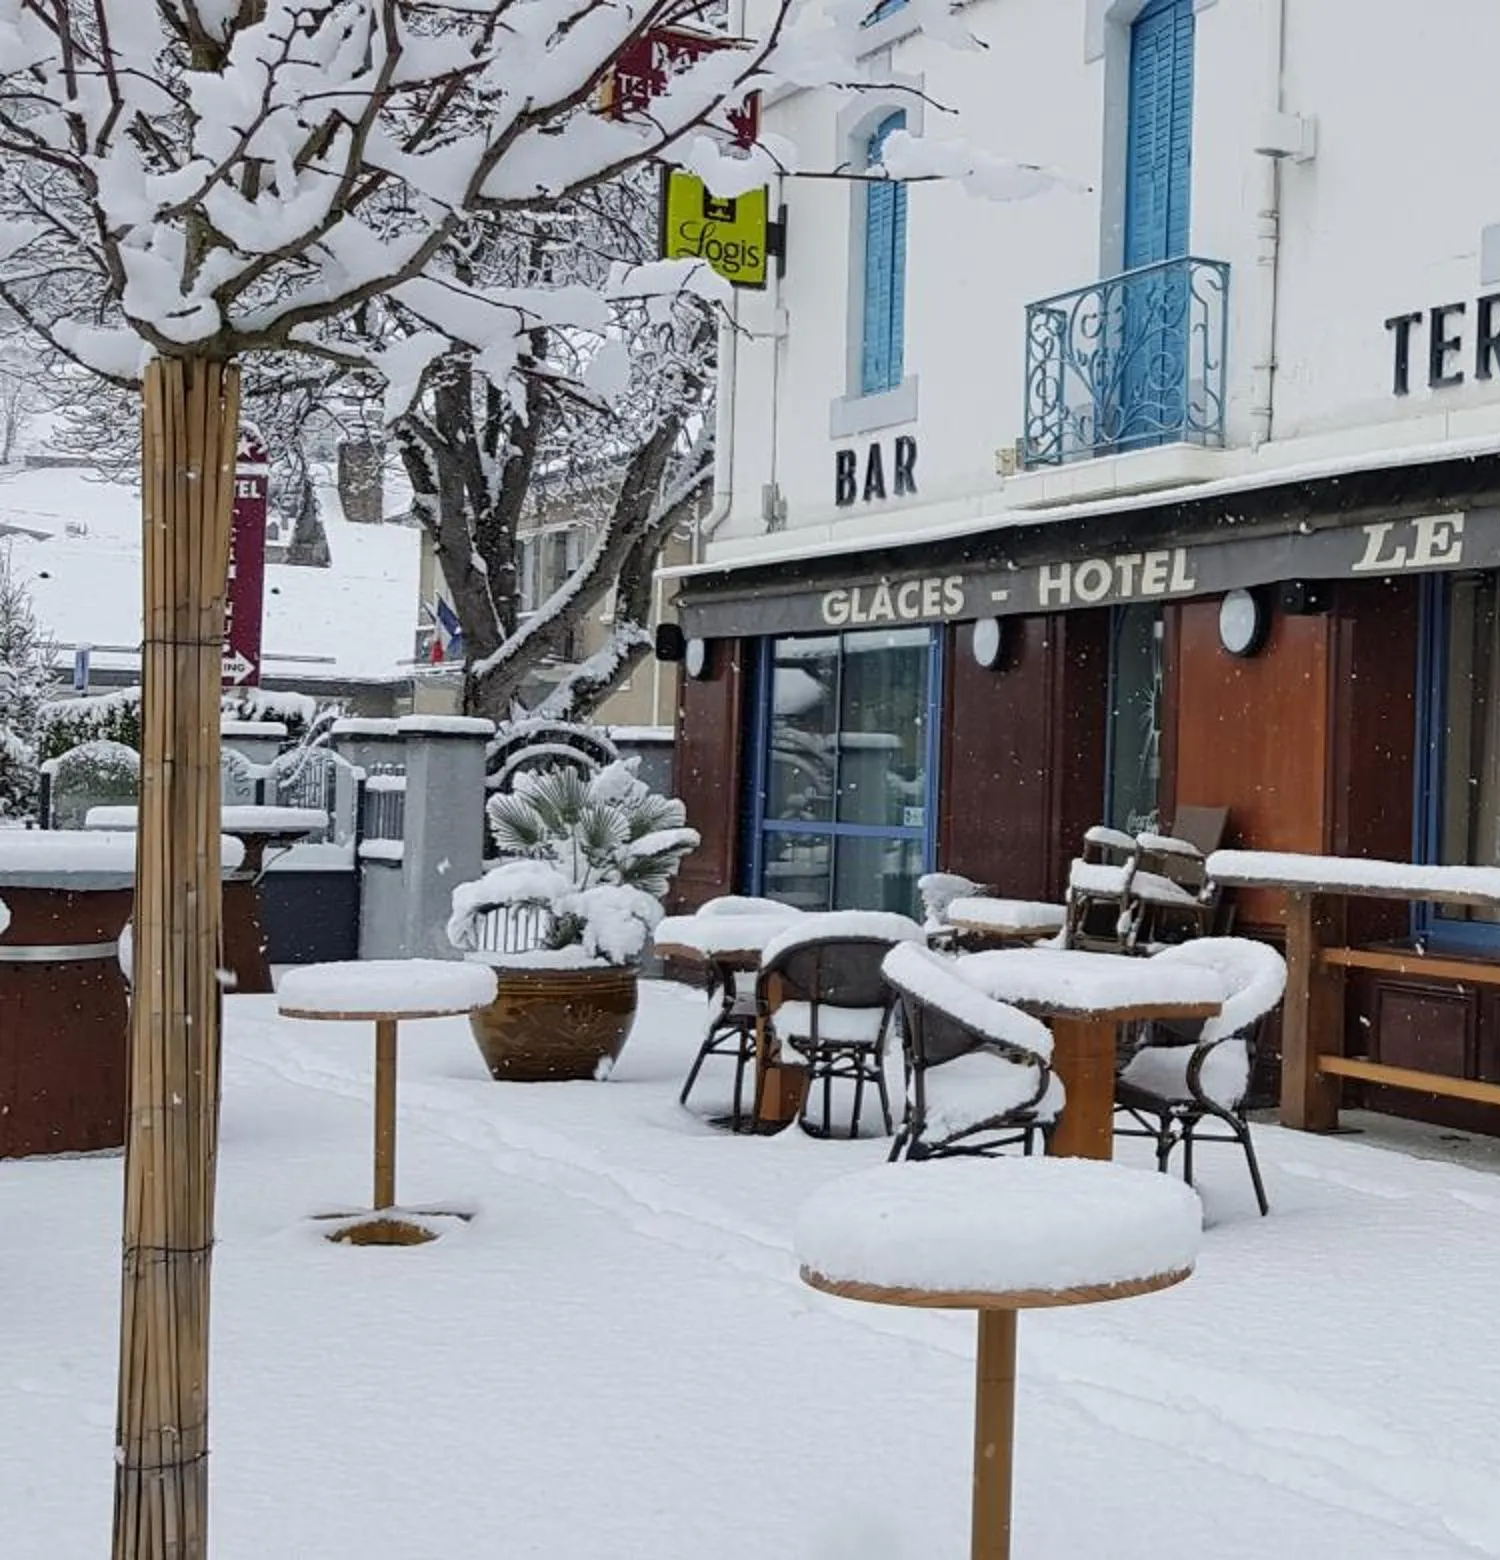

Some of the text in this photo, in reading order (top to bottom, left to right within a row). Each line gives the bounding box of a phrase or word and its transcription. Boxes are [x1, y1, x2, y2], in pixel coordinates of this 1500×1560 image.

[676, 221, 760, 273] Logis
[835, 436, 918, 506] BAR
[1350, 511, 1465, 572] LE
[1038, 547, 1195, 606] HOTEL
